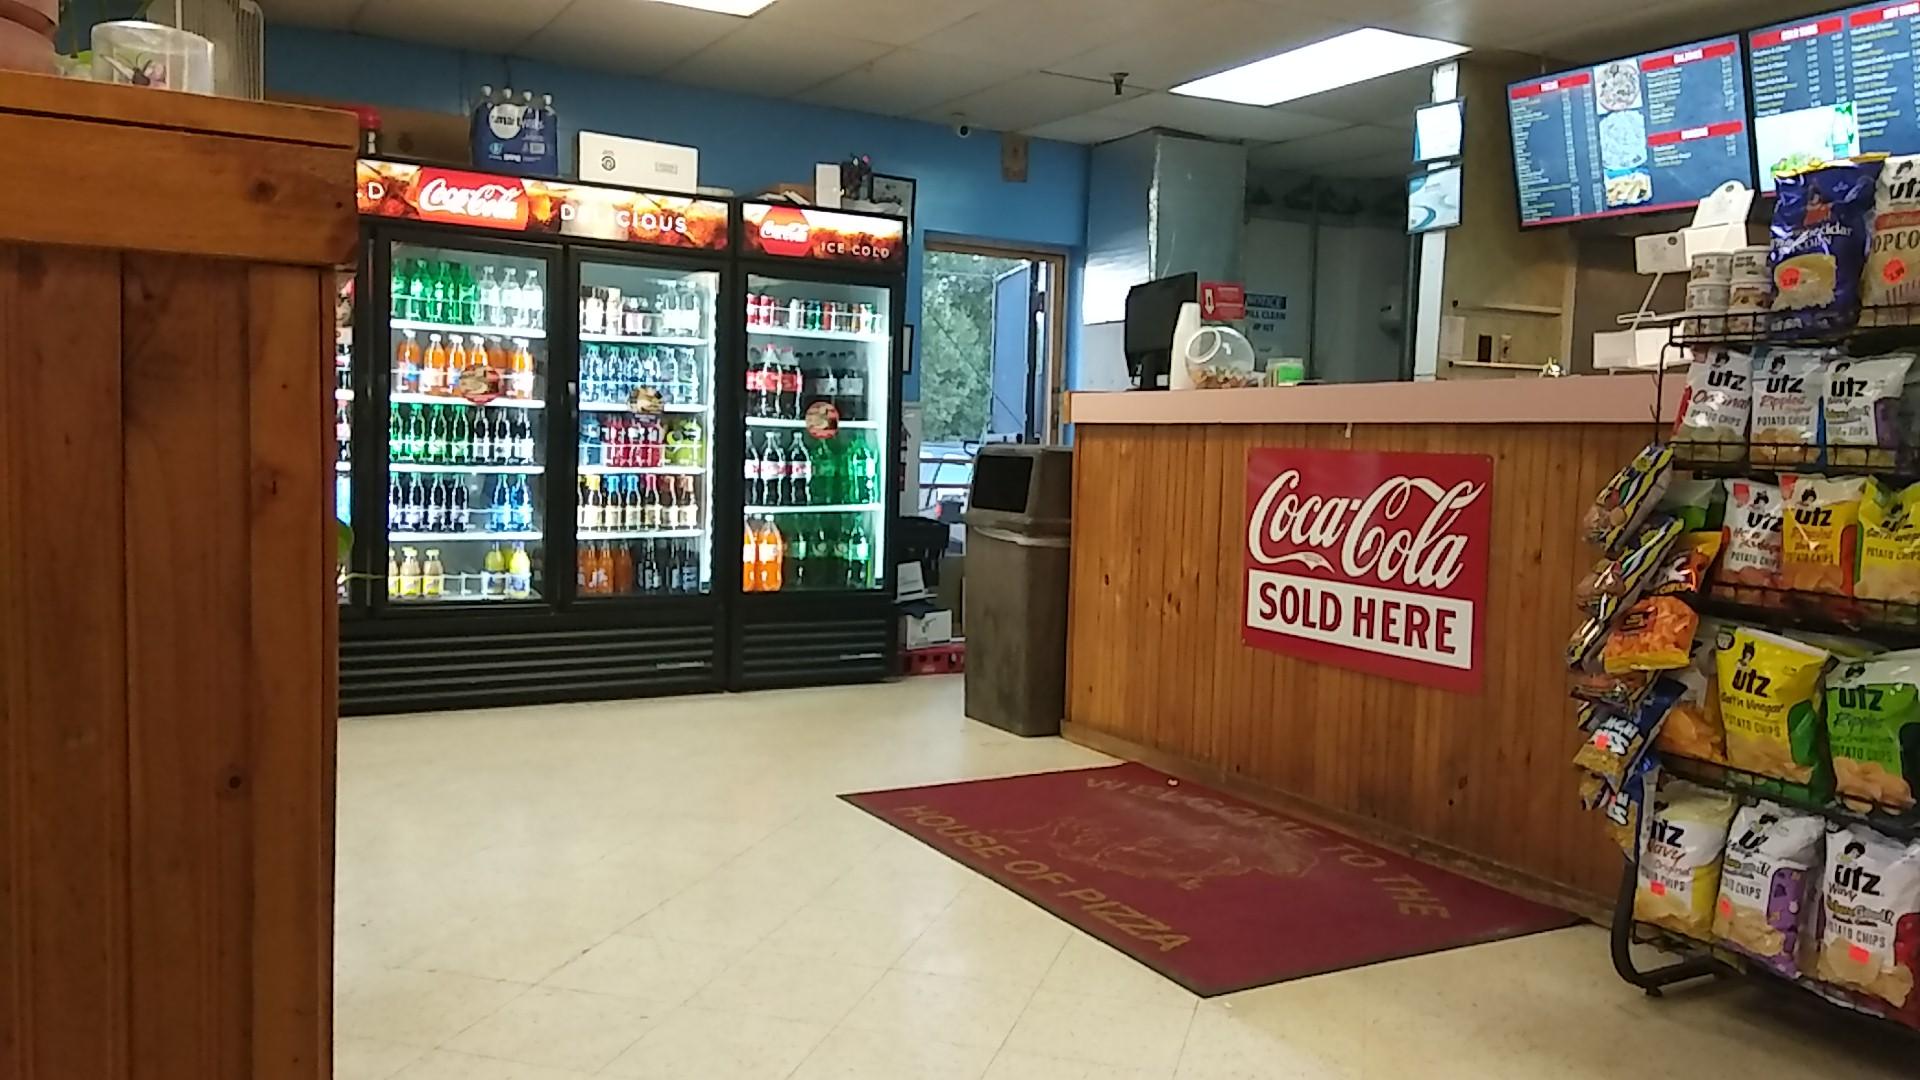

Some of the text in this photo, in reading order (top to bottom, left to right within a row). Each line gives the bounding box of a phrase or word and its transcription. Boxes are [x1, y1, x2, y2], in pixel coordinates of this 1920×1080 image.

[418, 178, 524, 220] Coca-Cola
[560, 203, 689, 234] DCIOUS
[820, 241, 891, 259] ICE COLD
[1708, 370, 1747, 391] utz
[1766, 374, 1804, 393] utz
[1831, 377, 1868, 397] utz
[1249, 469, 1487, 590] Coca-Cola
[1747, 512, 1783, 532] utz
[1795, 507, 1832, 527] utz
[1259, 581, 1457, 656] SOLD HERE
[1732, 668, 1771, 698] utz
[1838, 684, 1884, 712] utz
[894, 804, 1192, 952] HOUSE OF PIZZA
[1318, 842, 1388, 868] TO
[1371, 873, 1453, 919] THE
[1835, 863, 1882, 897] utz
